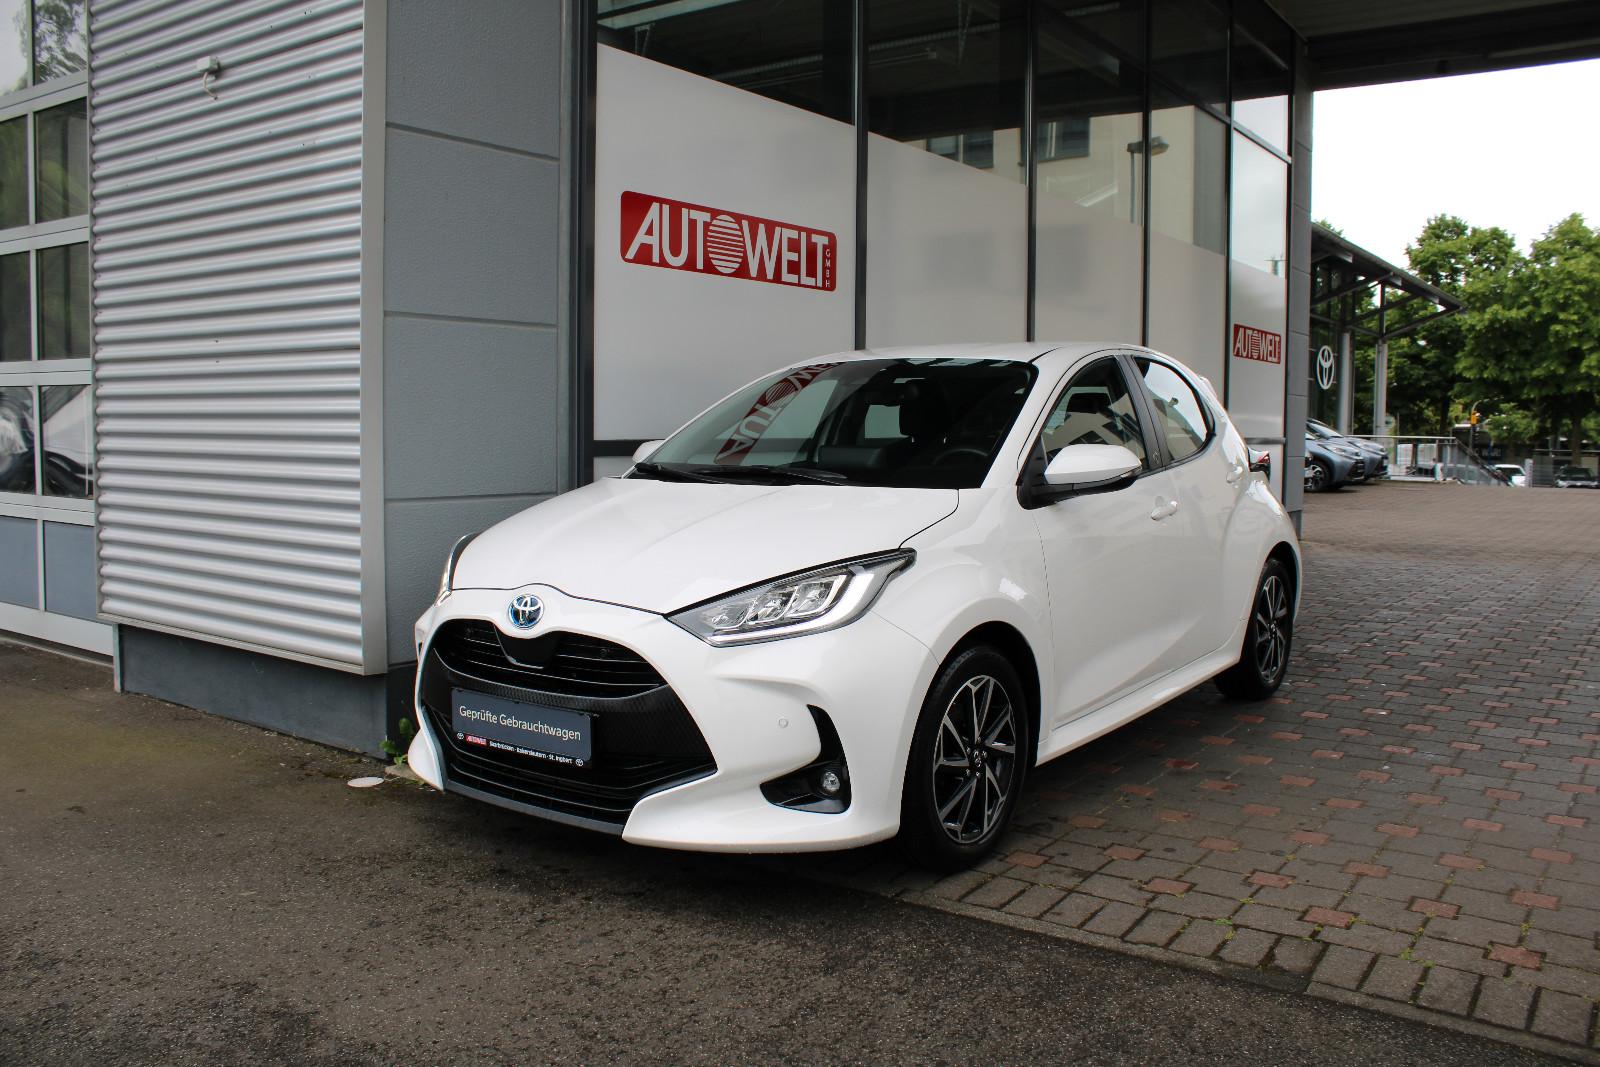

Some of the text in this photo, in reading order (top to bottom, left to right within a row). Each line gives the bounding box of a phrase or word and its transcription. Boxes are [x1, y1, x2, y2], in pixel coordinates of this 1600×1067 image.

[625, 202, 829, 287] AUTOWELT
[1233, 327, 1280, 363] AUTOWELT
[459, 705, 581, 741] Geprüfte Gebrauchtwagen
